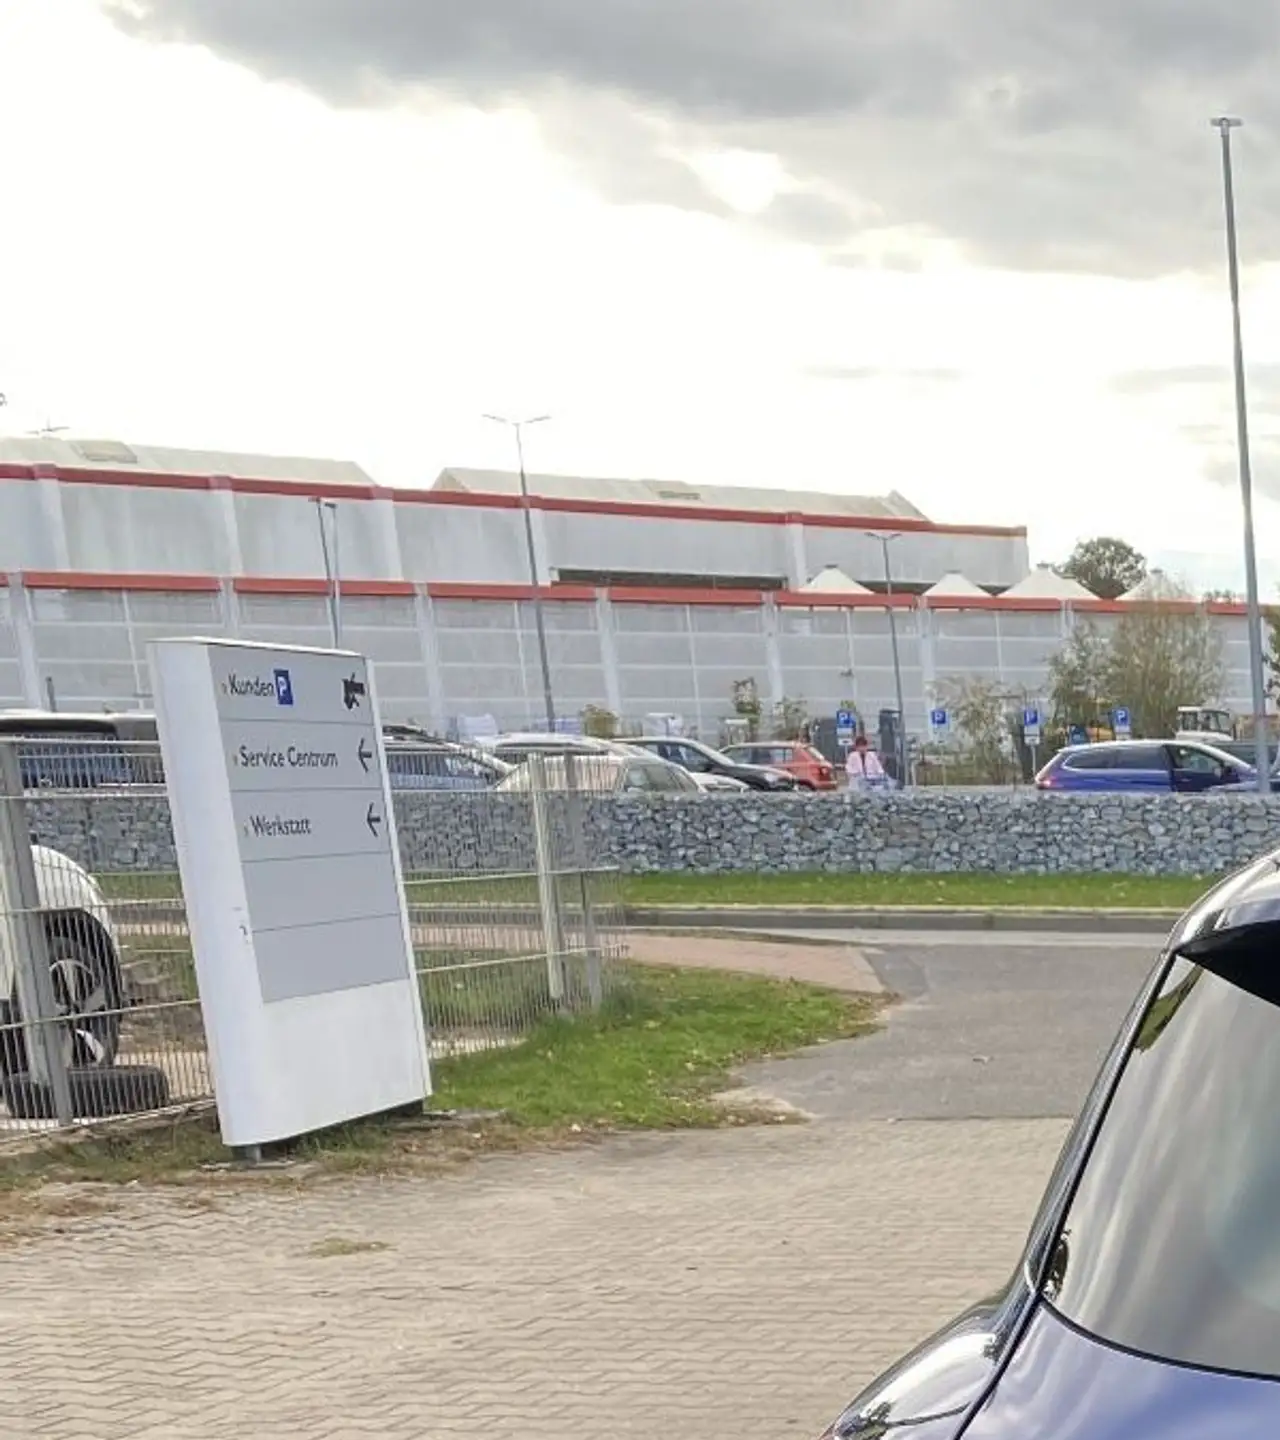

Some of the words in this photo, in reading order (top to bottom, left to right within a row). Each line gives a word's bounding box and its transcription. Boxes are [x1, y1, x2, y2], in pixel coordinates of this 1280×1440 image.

[228, 673, 275, 698] Kunden
[238, 744, 285, 768] Service
[287, 746, 339, 768] Centrum
[249, 815, 313, 838] Werkstatt
